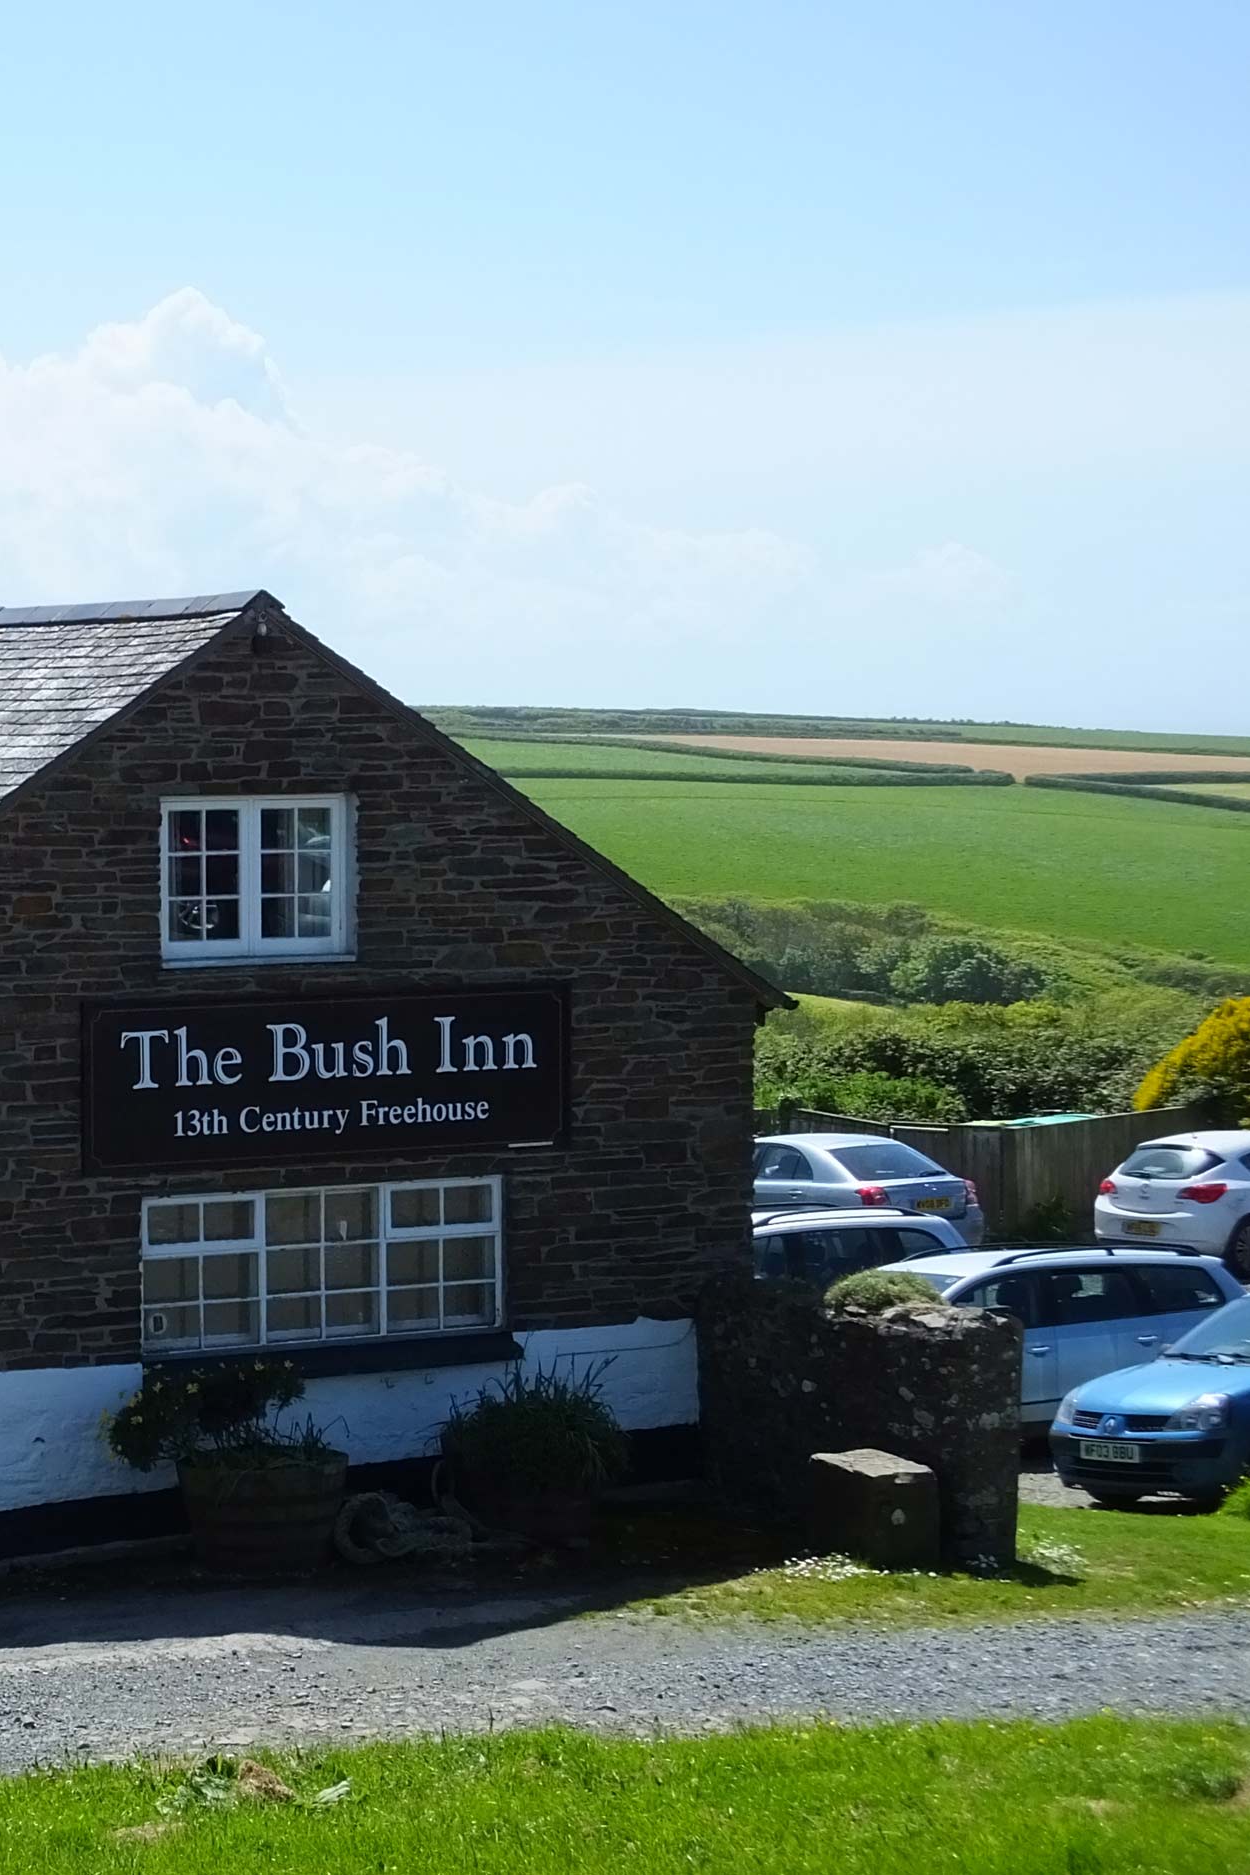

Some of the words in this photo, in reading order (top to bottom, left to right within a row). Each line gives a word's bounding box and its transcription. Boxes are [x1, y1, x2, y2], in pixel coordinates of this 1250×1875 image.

[120, 1026, 243, 1090] The
[265, 1017, 411, 1083] Bush
[434, 1016, 538, 1073] Inn
[173, 1109, 229, 1137] 13th
[239, 1105, 350, 1134] Century
[359, 1098, 490, 1127] Freehouse
